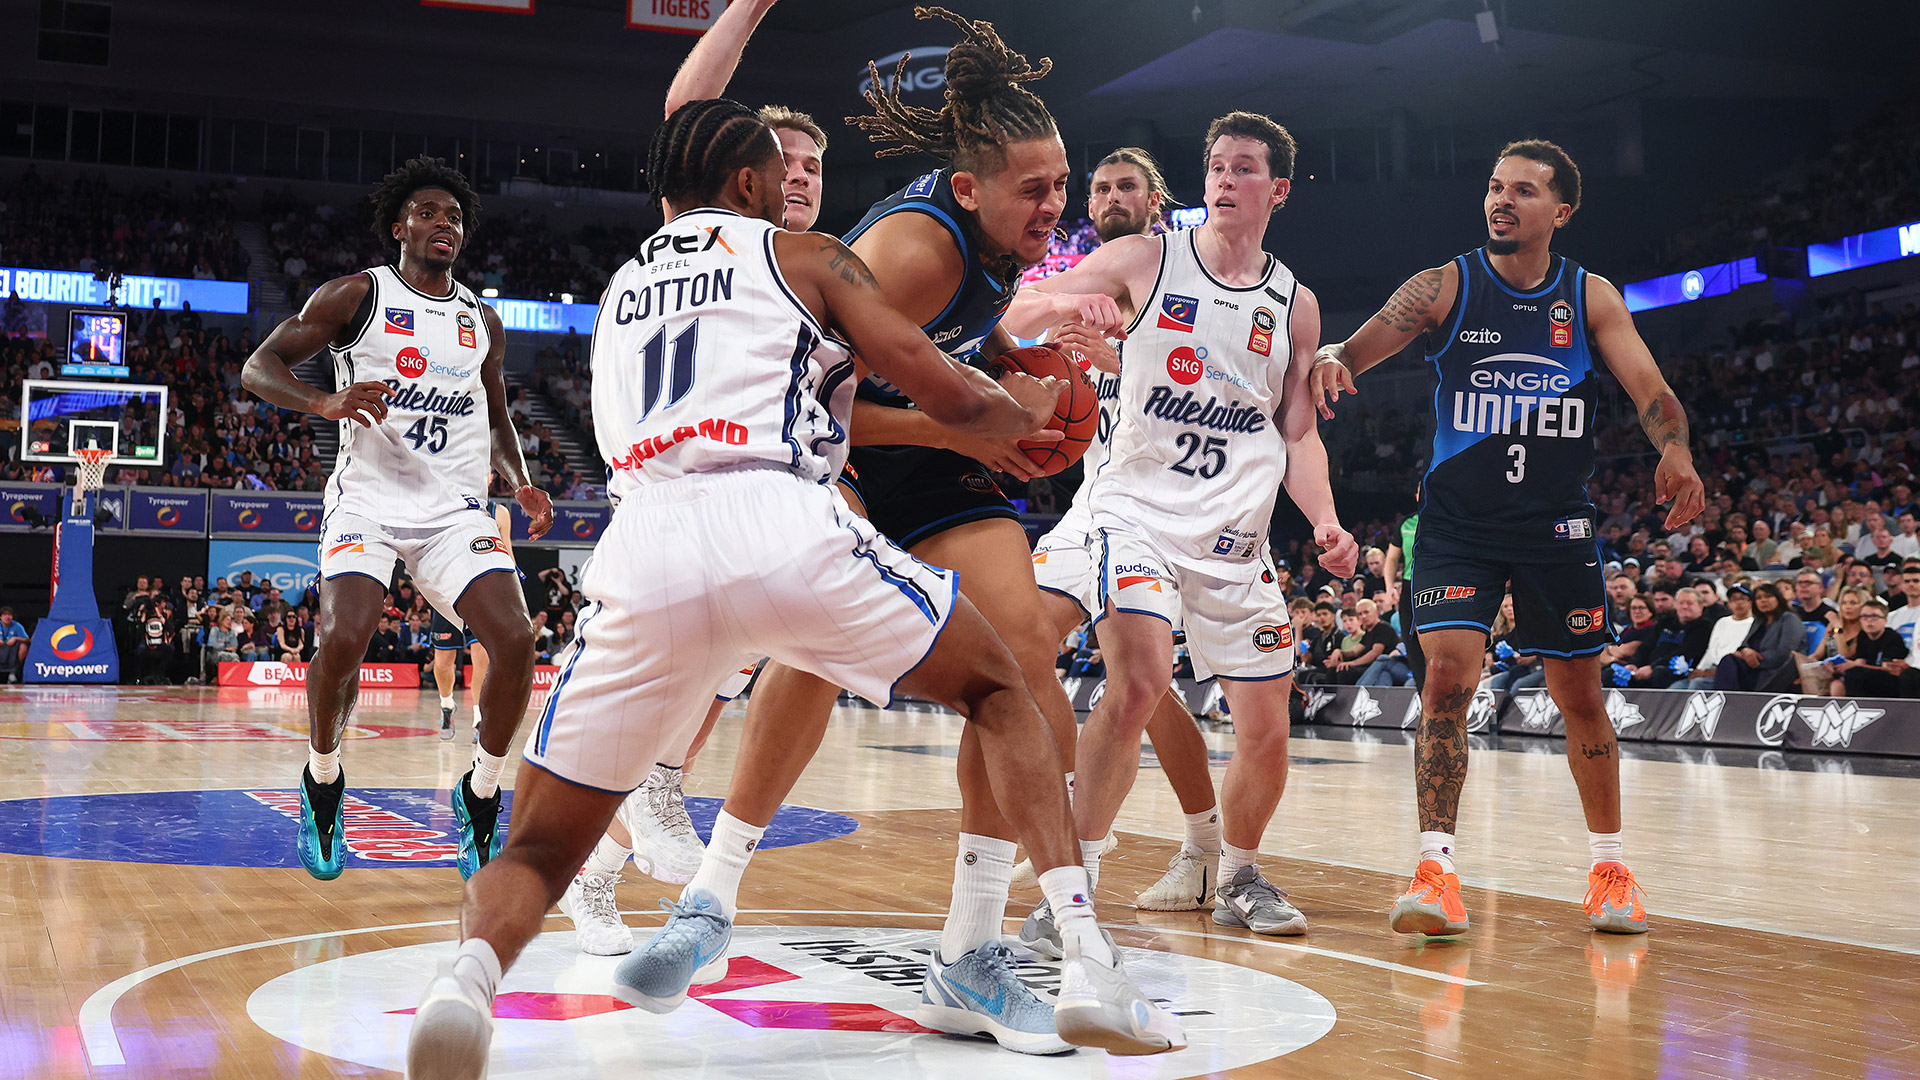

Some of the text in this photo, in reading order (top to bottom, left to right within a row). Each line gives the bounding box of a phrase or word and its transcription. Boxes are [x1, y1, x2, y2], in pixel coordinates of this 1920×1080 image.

[650, 0, 711, 19] TIGERS
[651, 259, 690, 274] STEEL
[615, 267, 735, 326] COTTON
[1165, 294, 1197, 305] Tyrepower
[1213, 298, 1240, 311] OPTUS
[425, 308, 446, 317] OPTUS
[497, 300, 562, 329] UNITED
[1512, 303, 1538, 312] OPTUS
[91, 317, 121, 335] 1:53
[1257, 312, 1271, 329] NBL
[1459, 327, 1502, 344] ozito
[90, 334, 116, 361] 14
[399, 355, 472, 379] SKG Services
[636, 316, 700, 425] 11
[1171, 356, 1254, 391] SKG Services
[380, 379, 475, 417] Adelaide
[1143, 385, 1266, 435] Adelaide
[1452, 391, 1586, 439] UNITED
[402, 416, 449, 455] 45
[1168, 431, 1229, 480] 25
[1505, 443, 1527, 484] 3
[1, 491, 44, 501] Tyrepower
[148, 497, 189, 506] Tyrepower
[229, 500, 269, 509] Tyrepower
[564, 510, 601, 519] Tyrepower
[335, 533, 364, 543] dget
[475, 541, 491, 550] NBL
[1571, 614, 1588, 627] NBL
[1259, 633, 1276, 645] NBL
[35, 662, 109, 678] Tyrepower
[264, 667, 307, 681] BEAU
